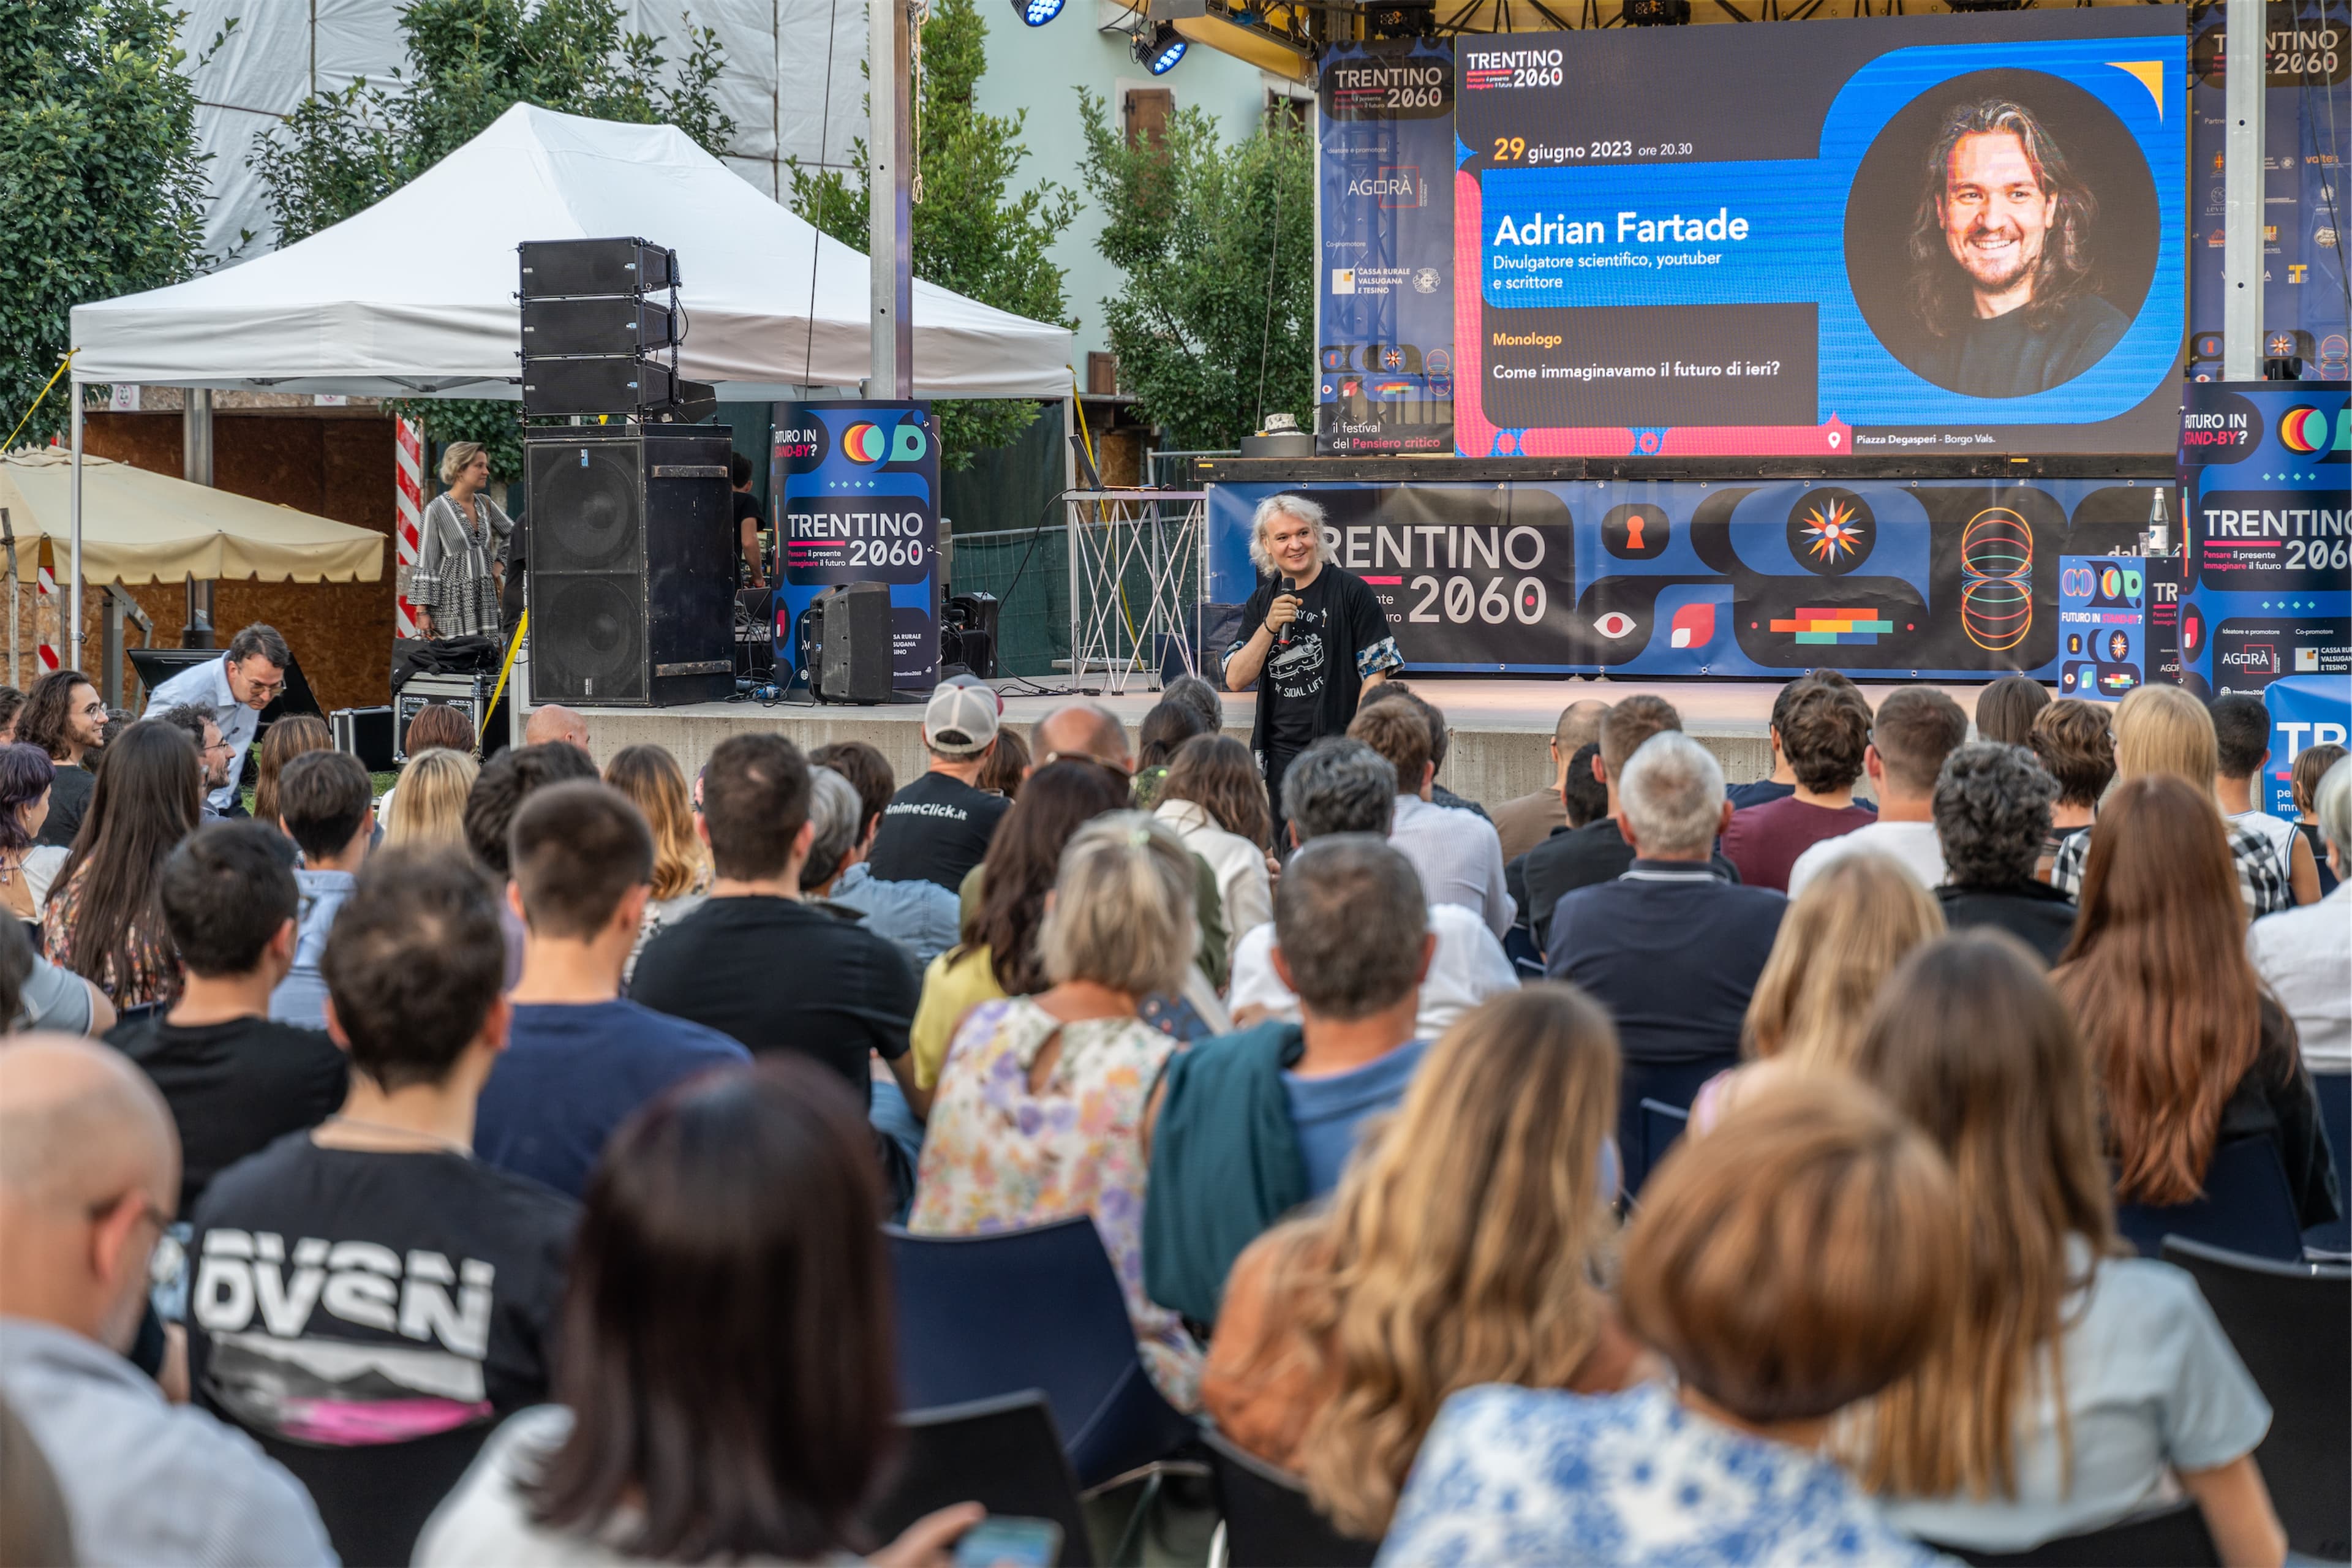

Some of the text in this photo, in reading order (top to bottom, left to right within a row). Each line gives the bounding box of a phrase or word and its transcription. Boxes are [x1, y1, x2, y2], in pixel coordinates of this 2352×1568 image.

[2214, 30, 2339, 53] TNTINO
[1467, 49, 1563, 69] TRENTINO
[2275, 51, 2338, 74] 2060
[1335, 67, 1442, 88] TRENTINO
[1514, 67, 1563, 88] 2060
[1387, 87, 1442, 108] 2060
[1494, 137, 1693, 164] 29 giugno 2023 ore 20.30
[1348, 174, 1412, 195] AGORÀ
[1493, 207, 1749, 246] Adrian Fartade
[1493, 251, 1722, 272] Divulgatore scientifico, youtuber
[1493, 275, 1563, 289] e scrittore
[1493, 332, 1562, 348] Monologo
[1493, 361, 1781, 381] Come immaginavamo il futuro di ieri?
[1333, 421, 1381, 433] il festival
[2185, 413, 2247, 429] FUTURO IN
[775, 429, 816, 443] FUTURO IN
[1333, 437, 1441, 448] del Pensiero critico
[1856, 435, 1886, 444] Piazza
[1888, 434, 1936, 446] Degasperi
[1945, 434, 1973, 445] Borgo
[1975, 434, 1996, 443] Vals.
[2184, 431, 2248, 445] STAND-BY?
[775, 444, 818, 458] STAND-BY?
[788, 512, 924, 537] TRENTINO
[849, 539, 923, 566] 2060
[1323, 526, 1545, 570] RENTINO
[2240, 551, 2275, 560] presente
[2285, 540, 2351, 570] 206
[2204, 562, 2247, 571] Immaginare
[1409, 575, 1547, 625] 2060
[1306, 612, 1318, 622] OF
[2062, 612, 2143, 624] FUTURO IN STAND-BY?
[2222, 650, 2269, 665] AGORÀ
[1284, 687, 1306, 698] SOCIAL
